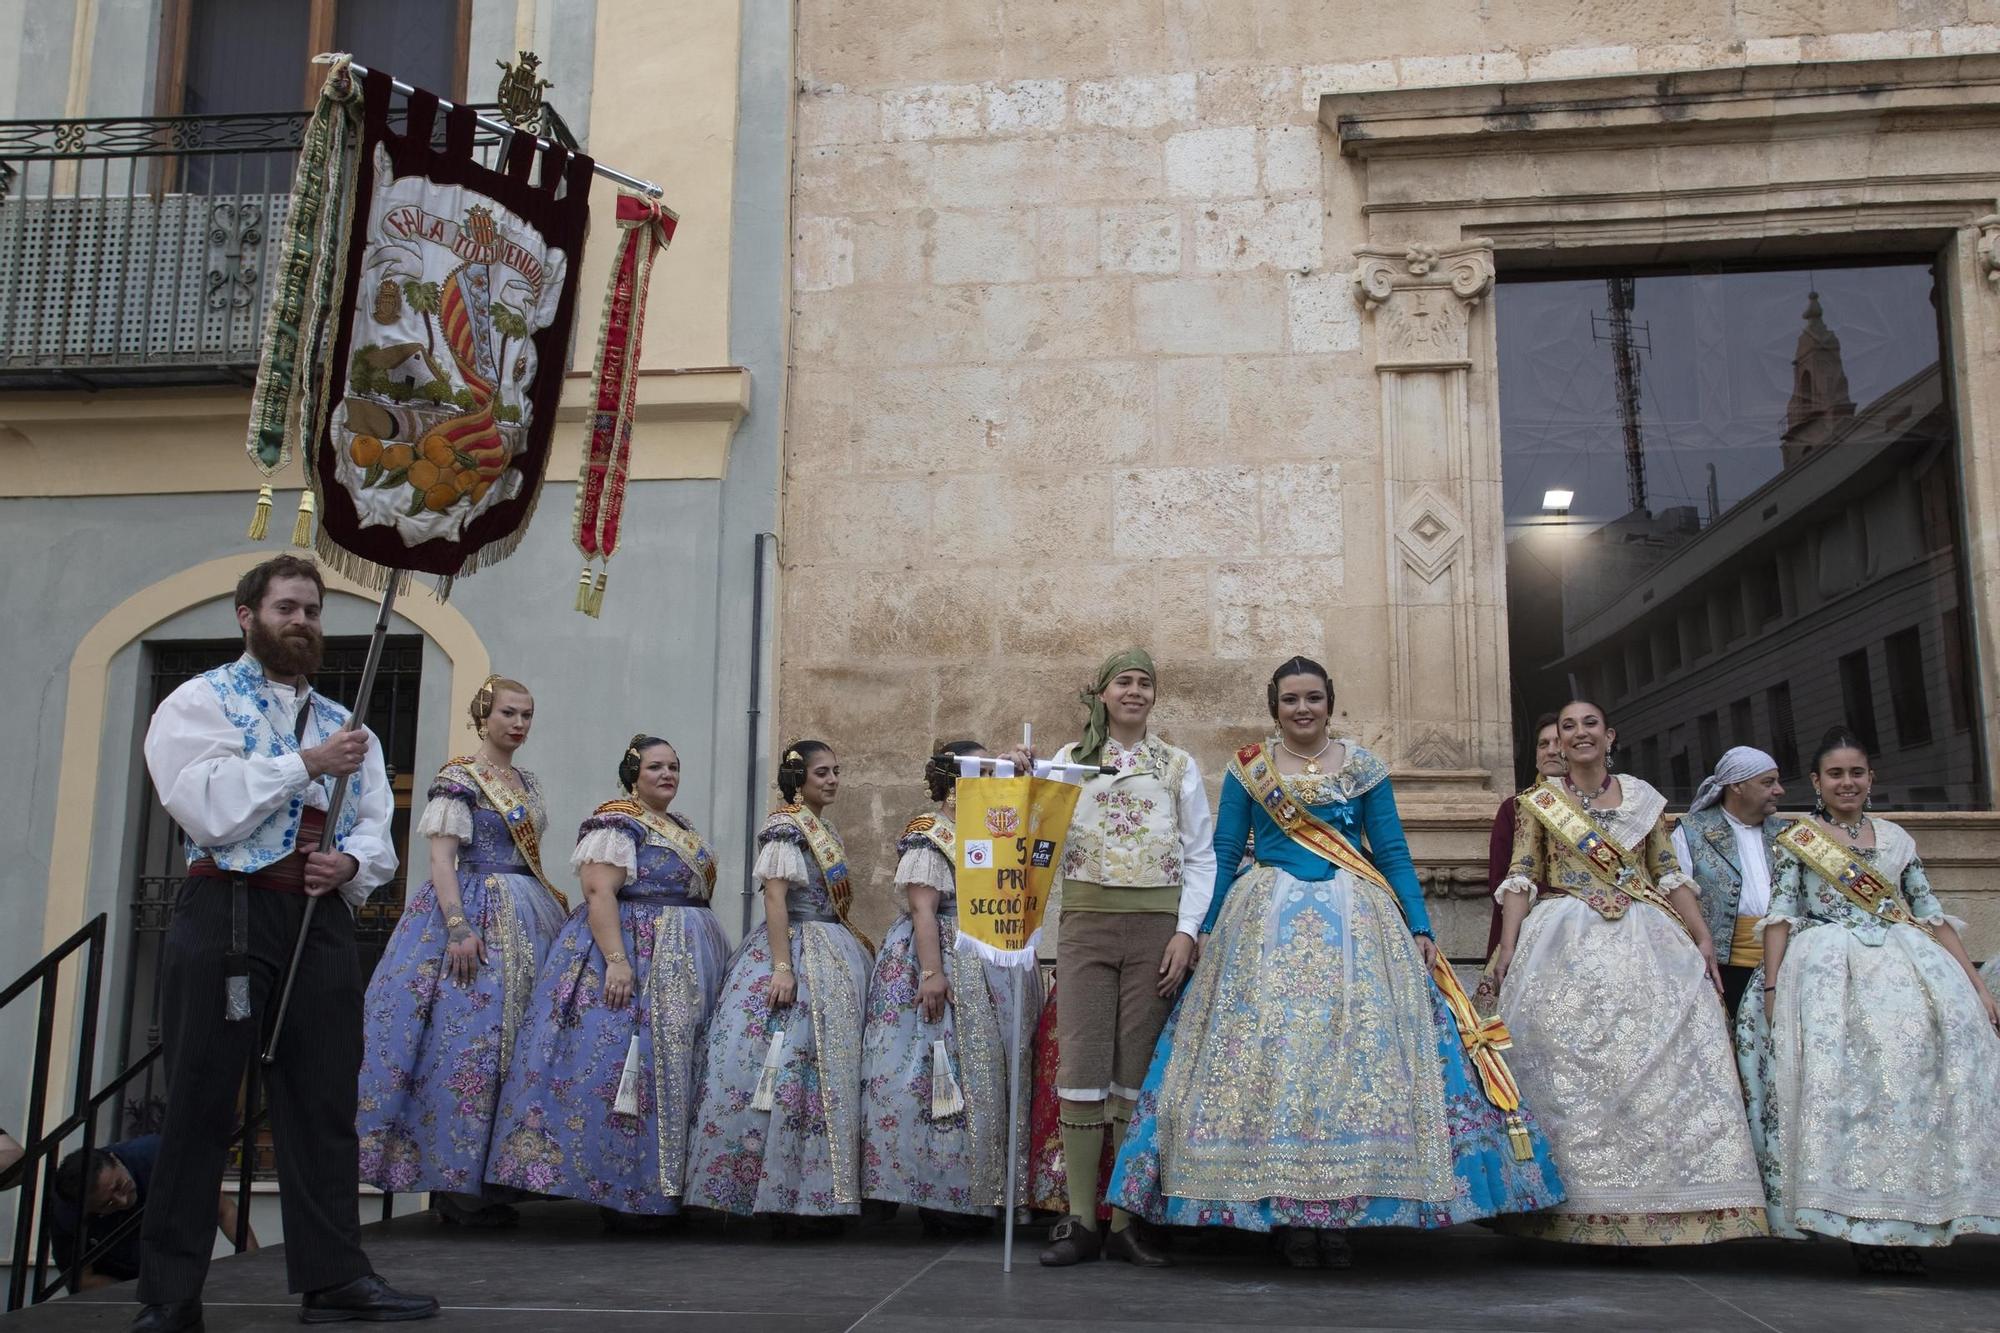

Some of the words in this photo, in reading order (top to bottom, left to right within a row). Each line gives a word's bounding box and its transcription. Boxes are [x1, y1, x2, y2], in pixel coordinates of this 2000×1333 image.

[387, 208, 444, 242] FALLA
[584, 472, 599, 525] 2021-2022
[1017, 837, 1027, 865] 5
